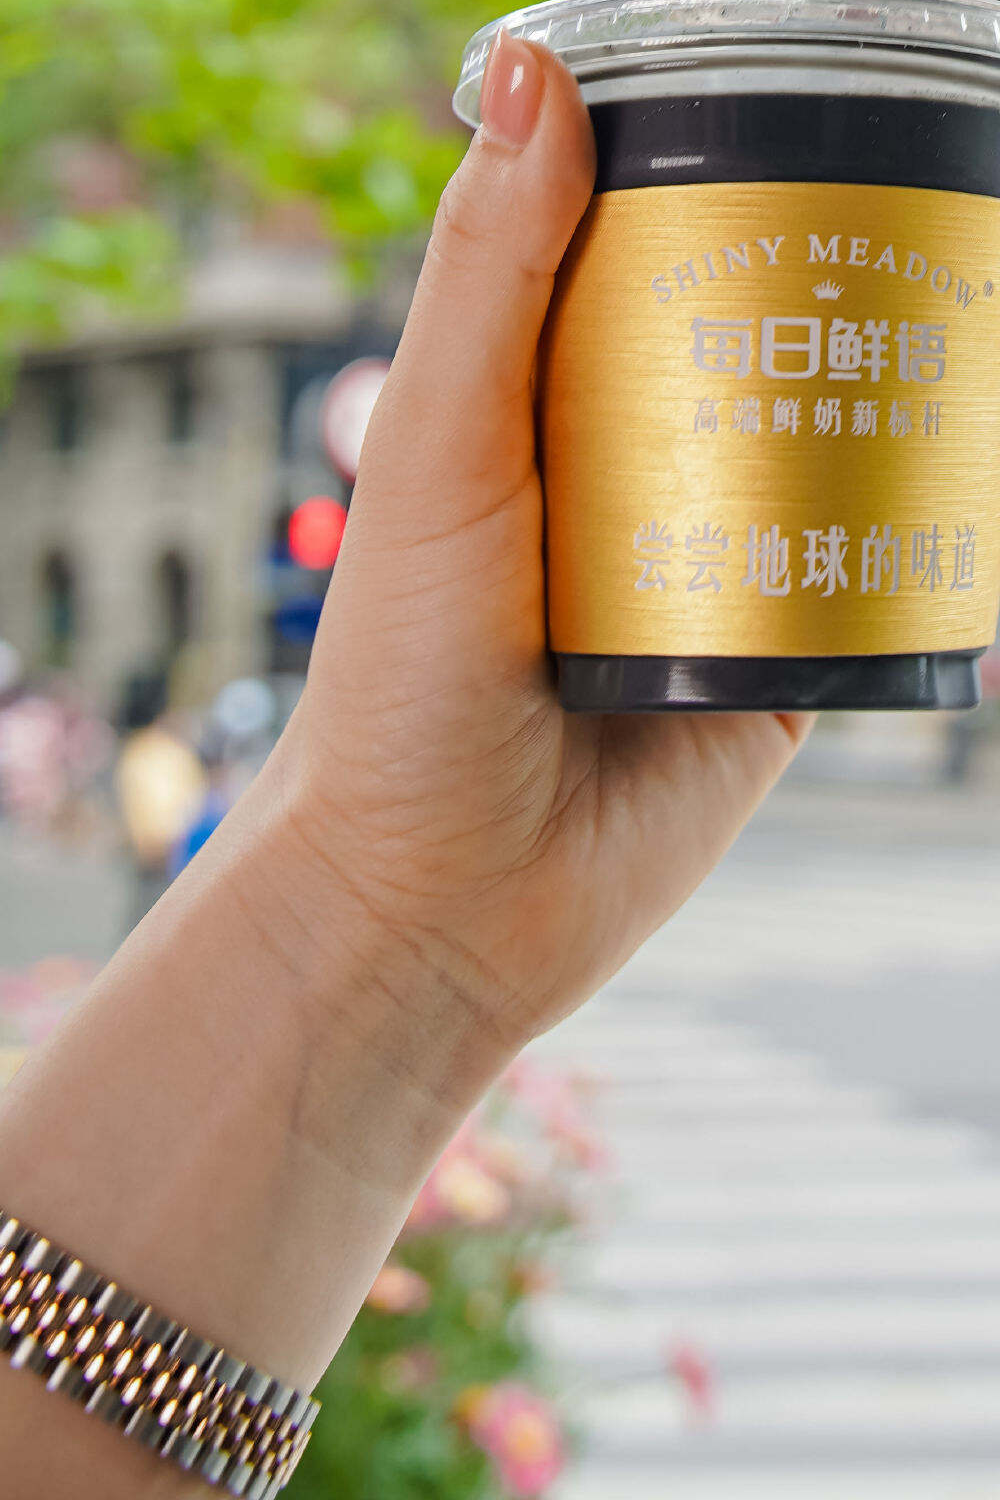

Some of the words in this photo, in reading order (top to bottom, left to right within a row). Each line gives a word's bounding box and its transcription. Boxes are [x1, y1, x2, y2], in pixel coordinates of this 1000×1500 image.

[649, 233, 787, 305] SHINY
[806, 233, 979, 311] MEADOW
[689, 315, 949, 384] 每日鲜语
[692, 395, 944, 438] 高端鲜奶新标杆
[631, 519, 980, 598] 尝尝地球的味道
